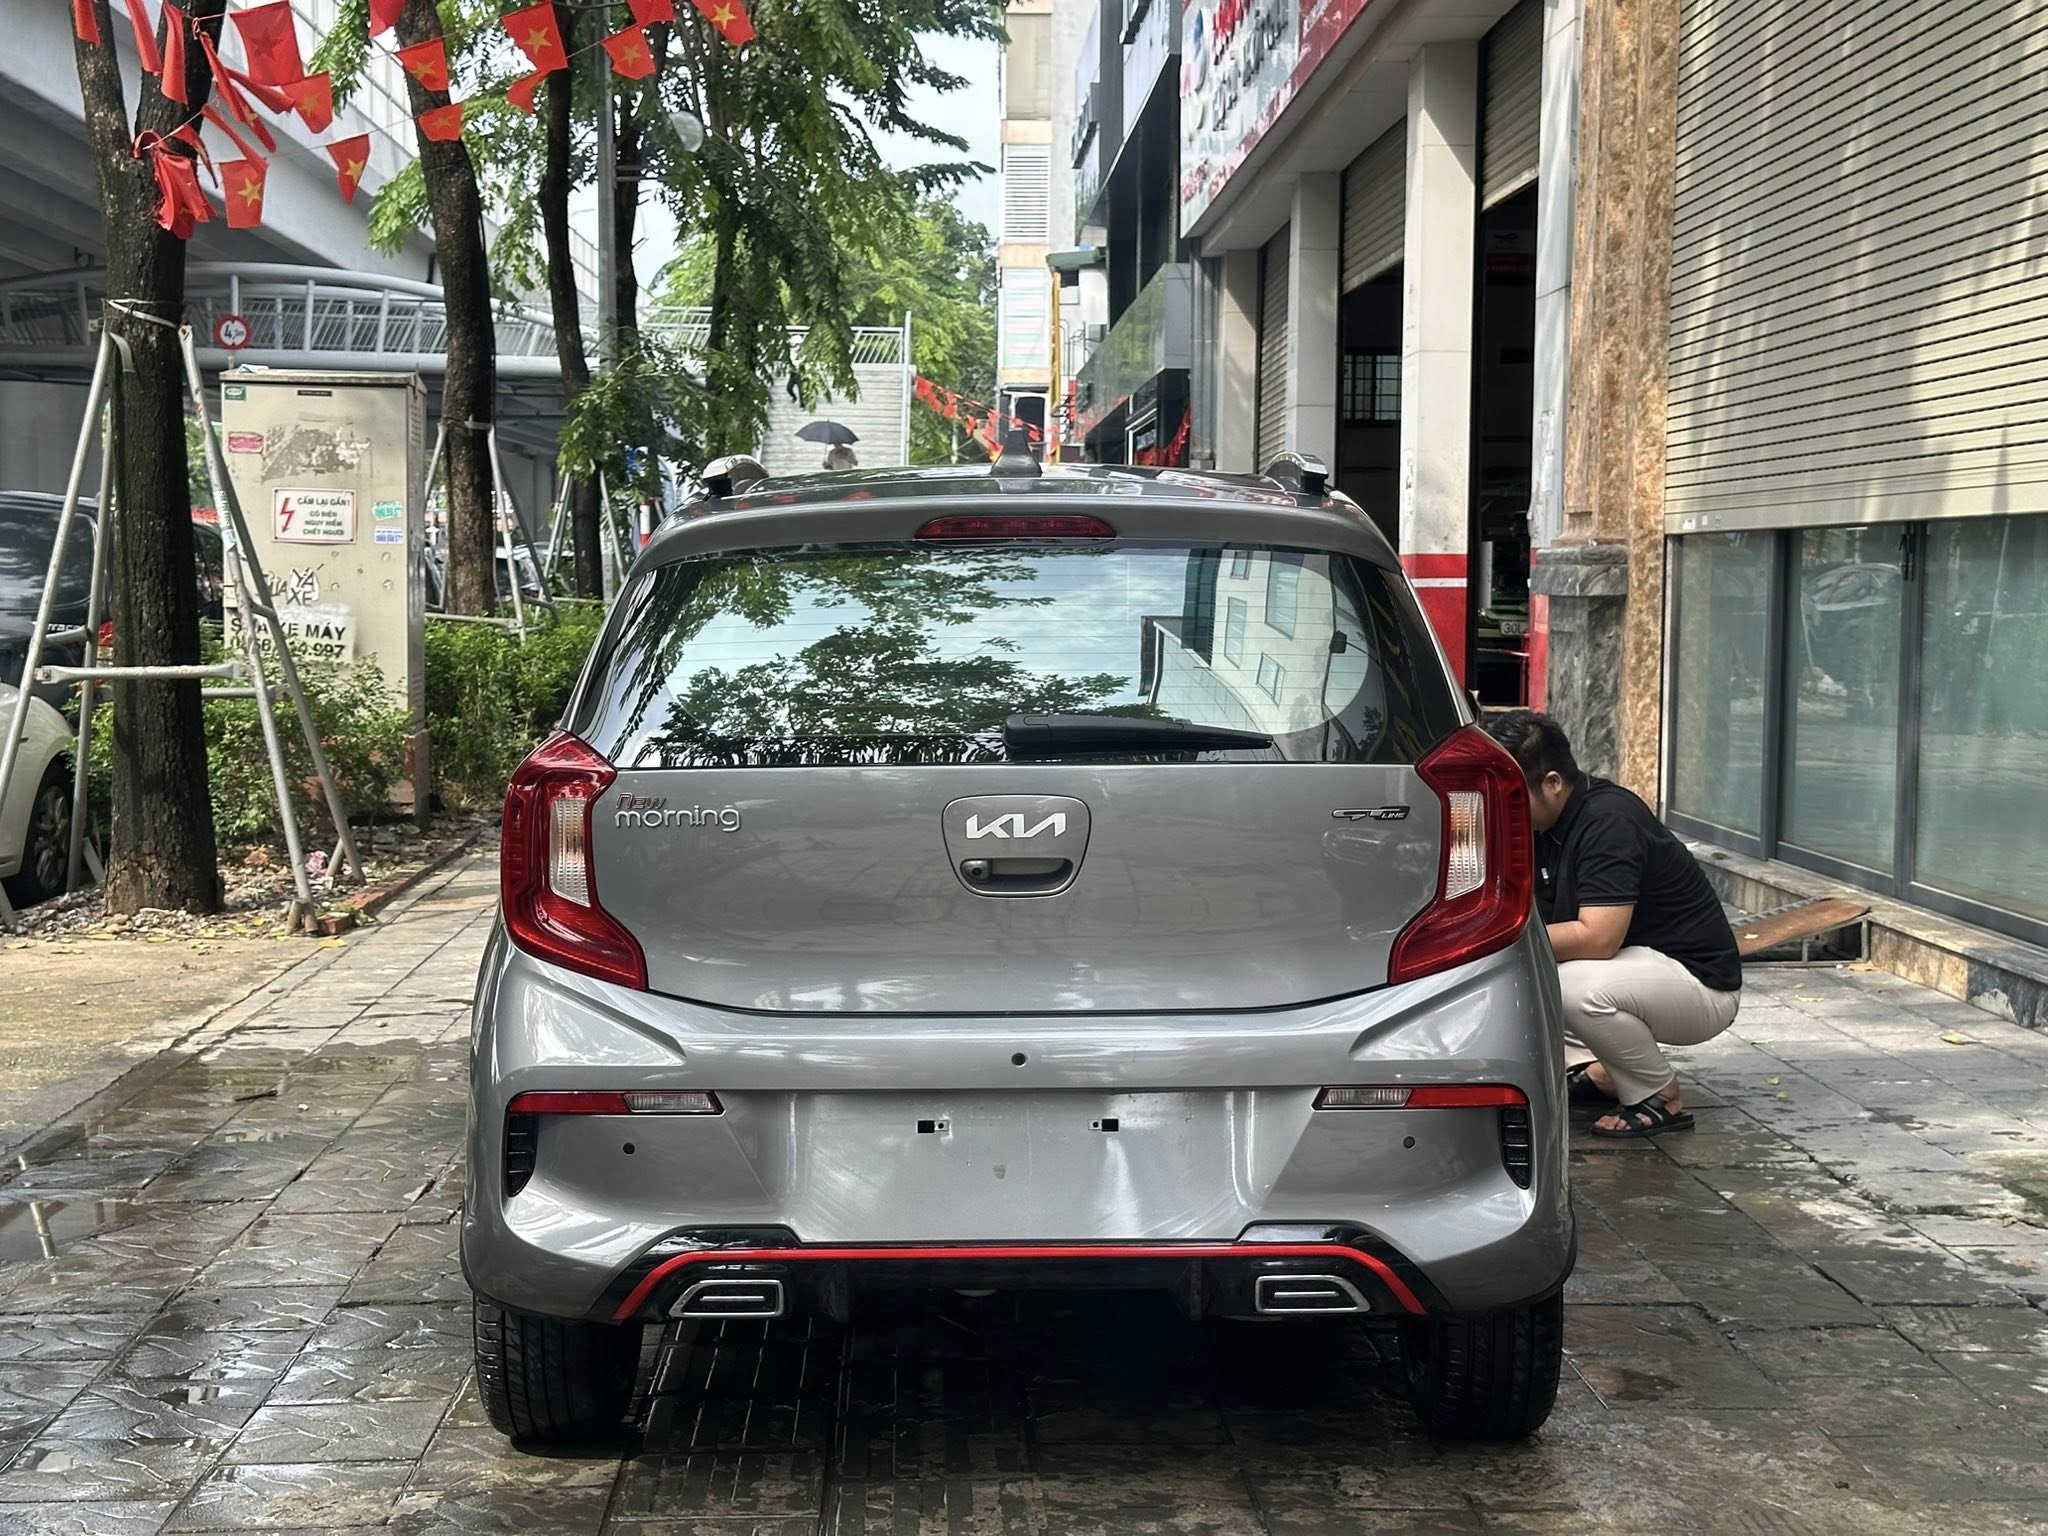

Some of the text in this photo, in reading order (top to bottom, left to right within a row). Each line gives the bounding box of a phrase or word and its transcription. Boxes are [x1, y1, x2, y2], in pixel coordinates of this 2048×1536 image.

[305, 621, 346, 641] MÁY
[614, 804, 741, 833] morning
[966, 812, 1066, 839] KIA
